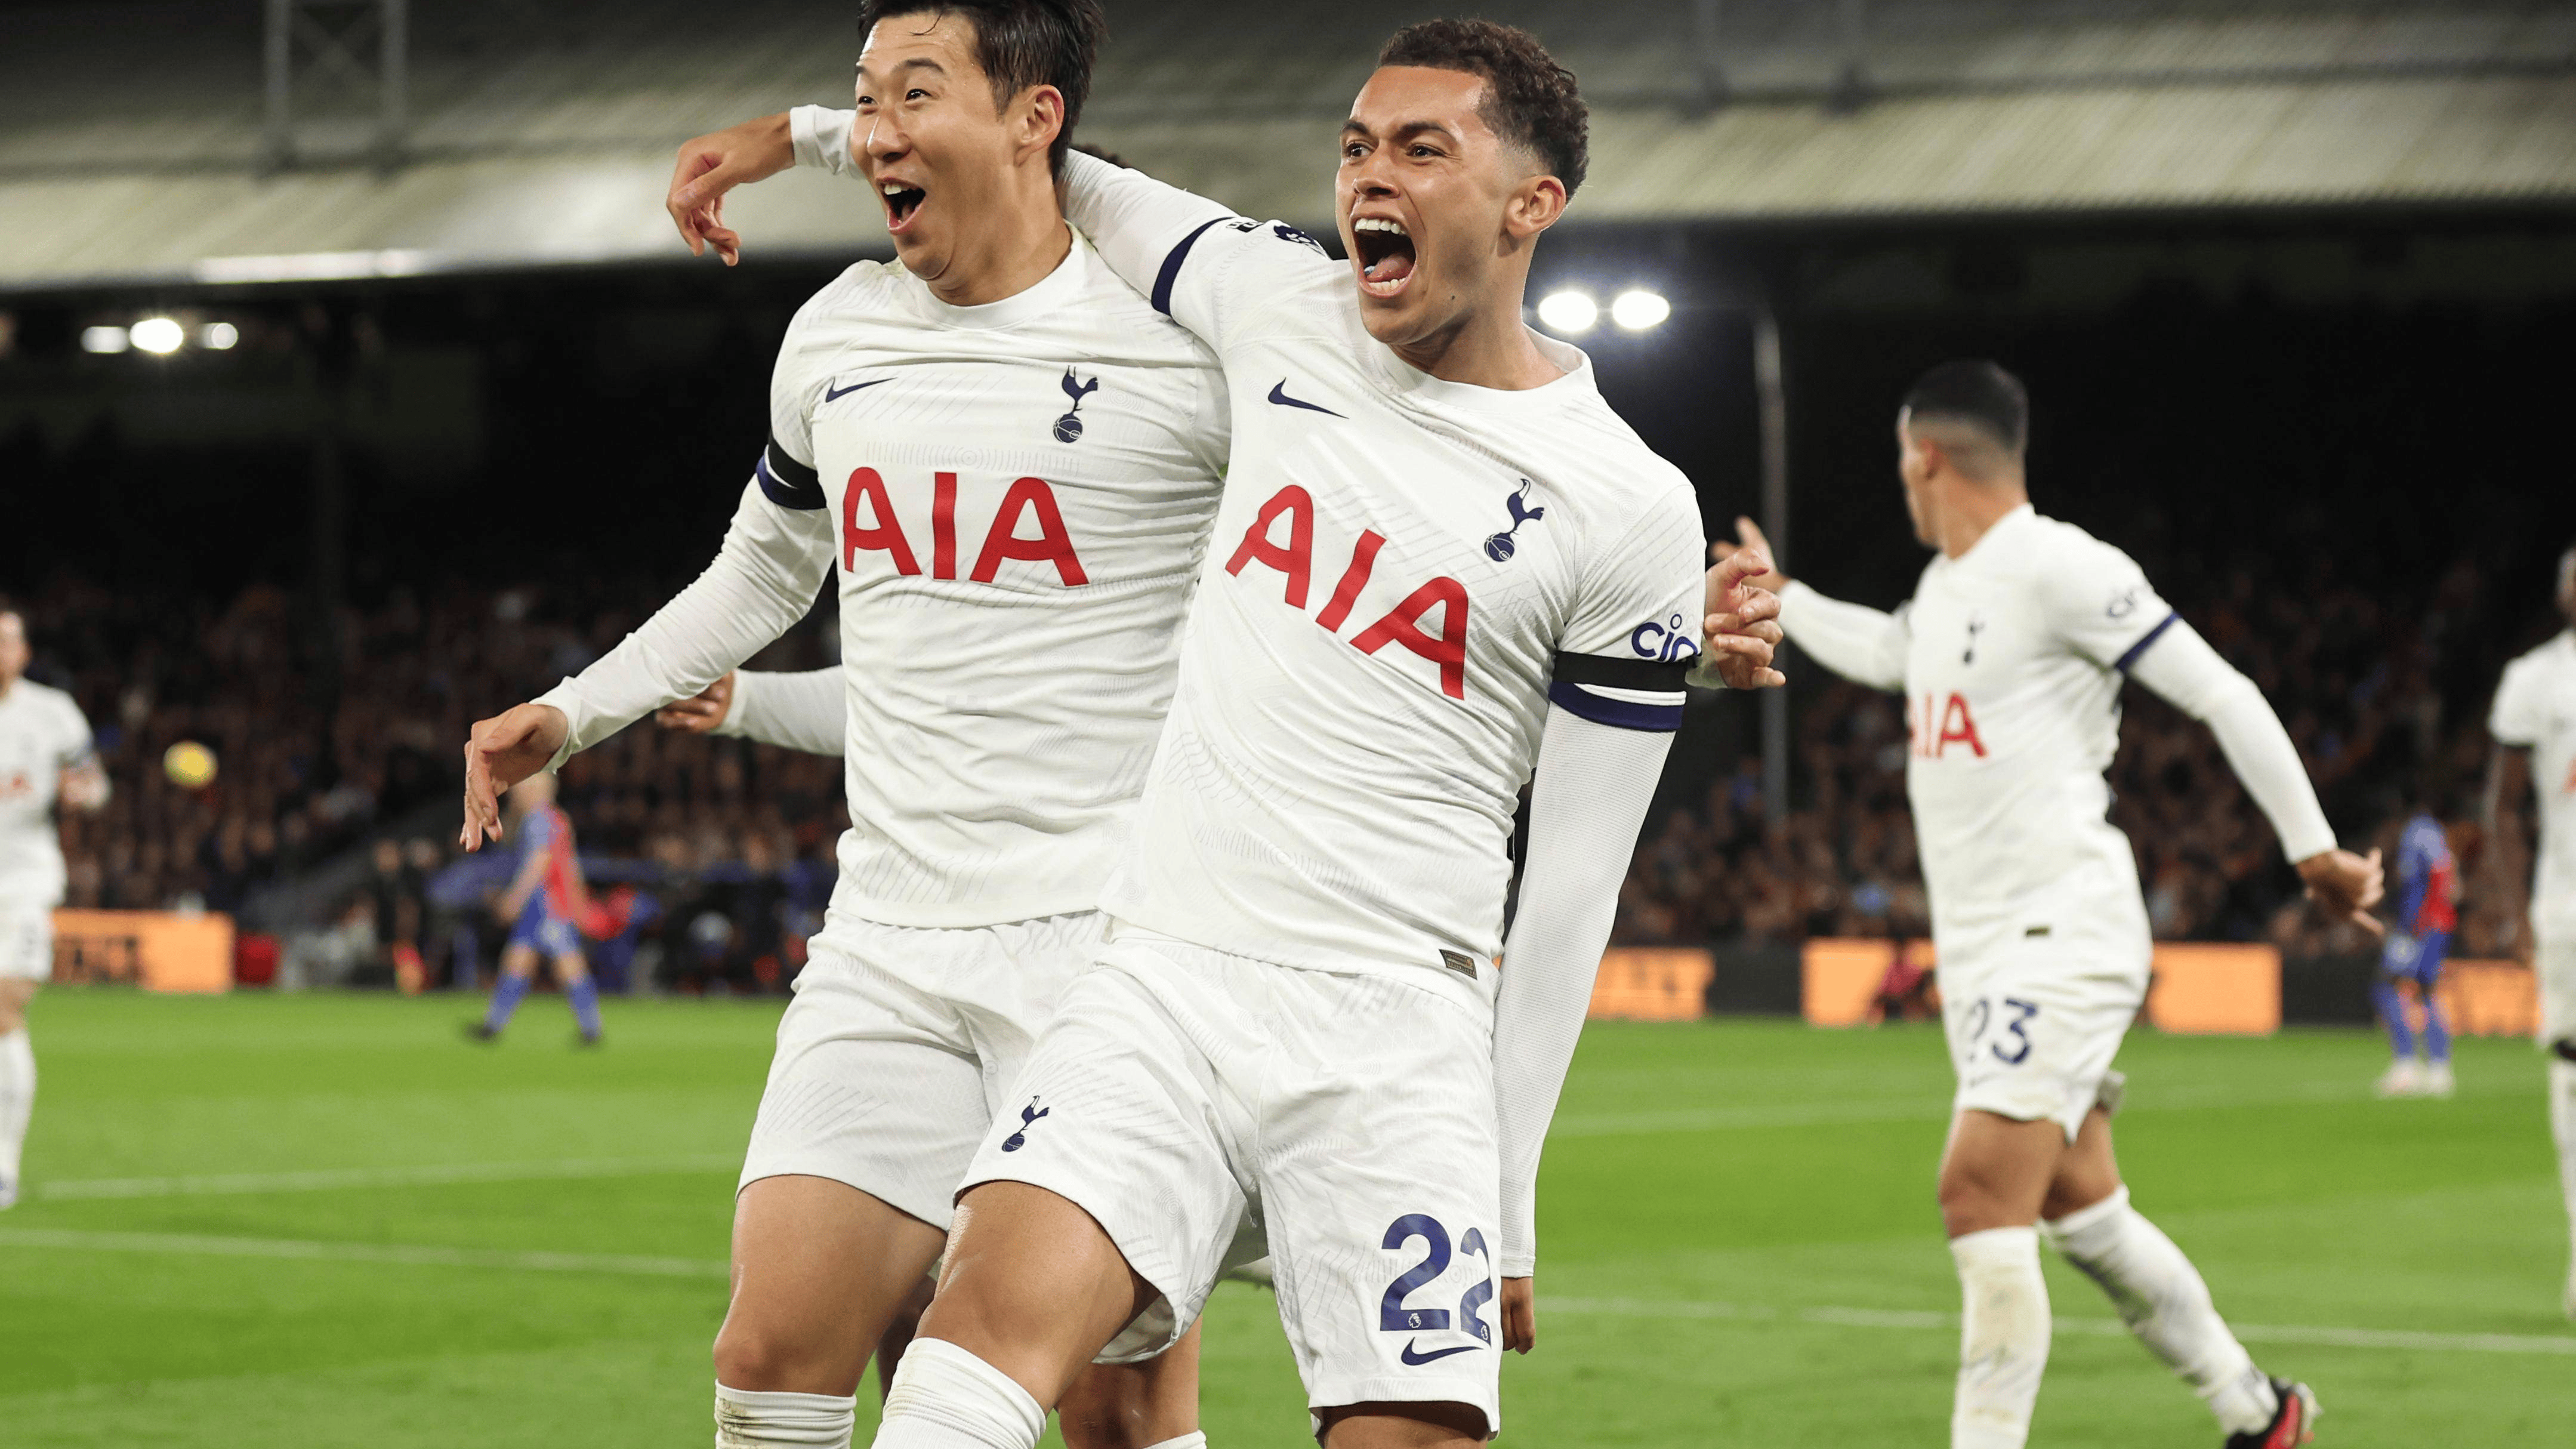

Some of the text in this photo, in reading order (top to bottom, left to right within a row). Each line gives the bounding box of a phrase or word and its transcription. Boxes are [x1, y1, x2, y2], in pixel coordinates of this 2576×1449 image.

[843, 467, 1090, 587] AIA
[1225, 484, 1469, 700] AIA
[1379, 1213, 1493, 1348] 22
